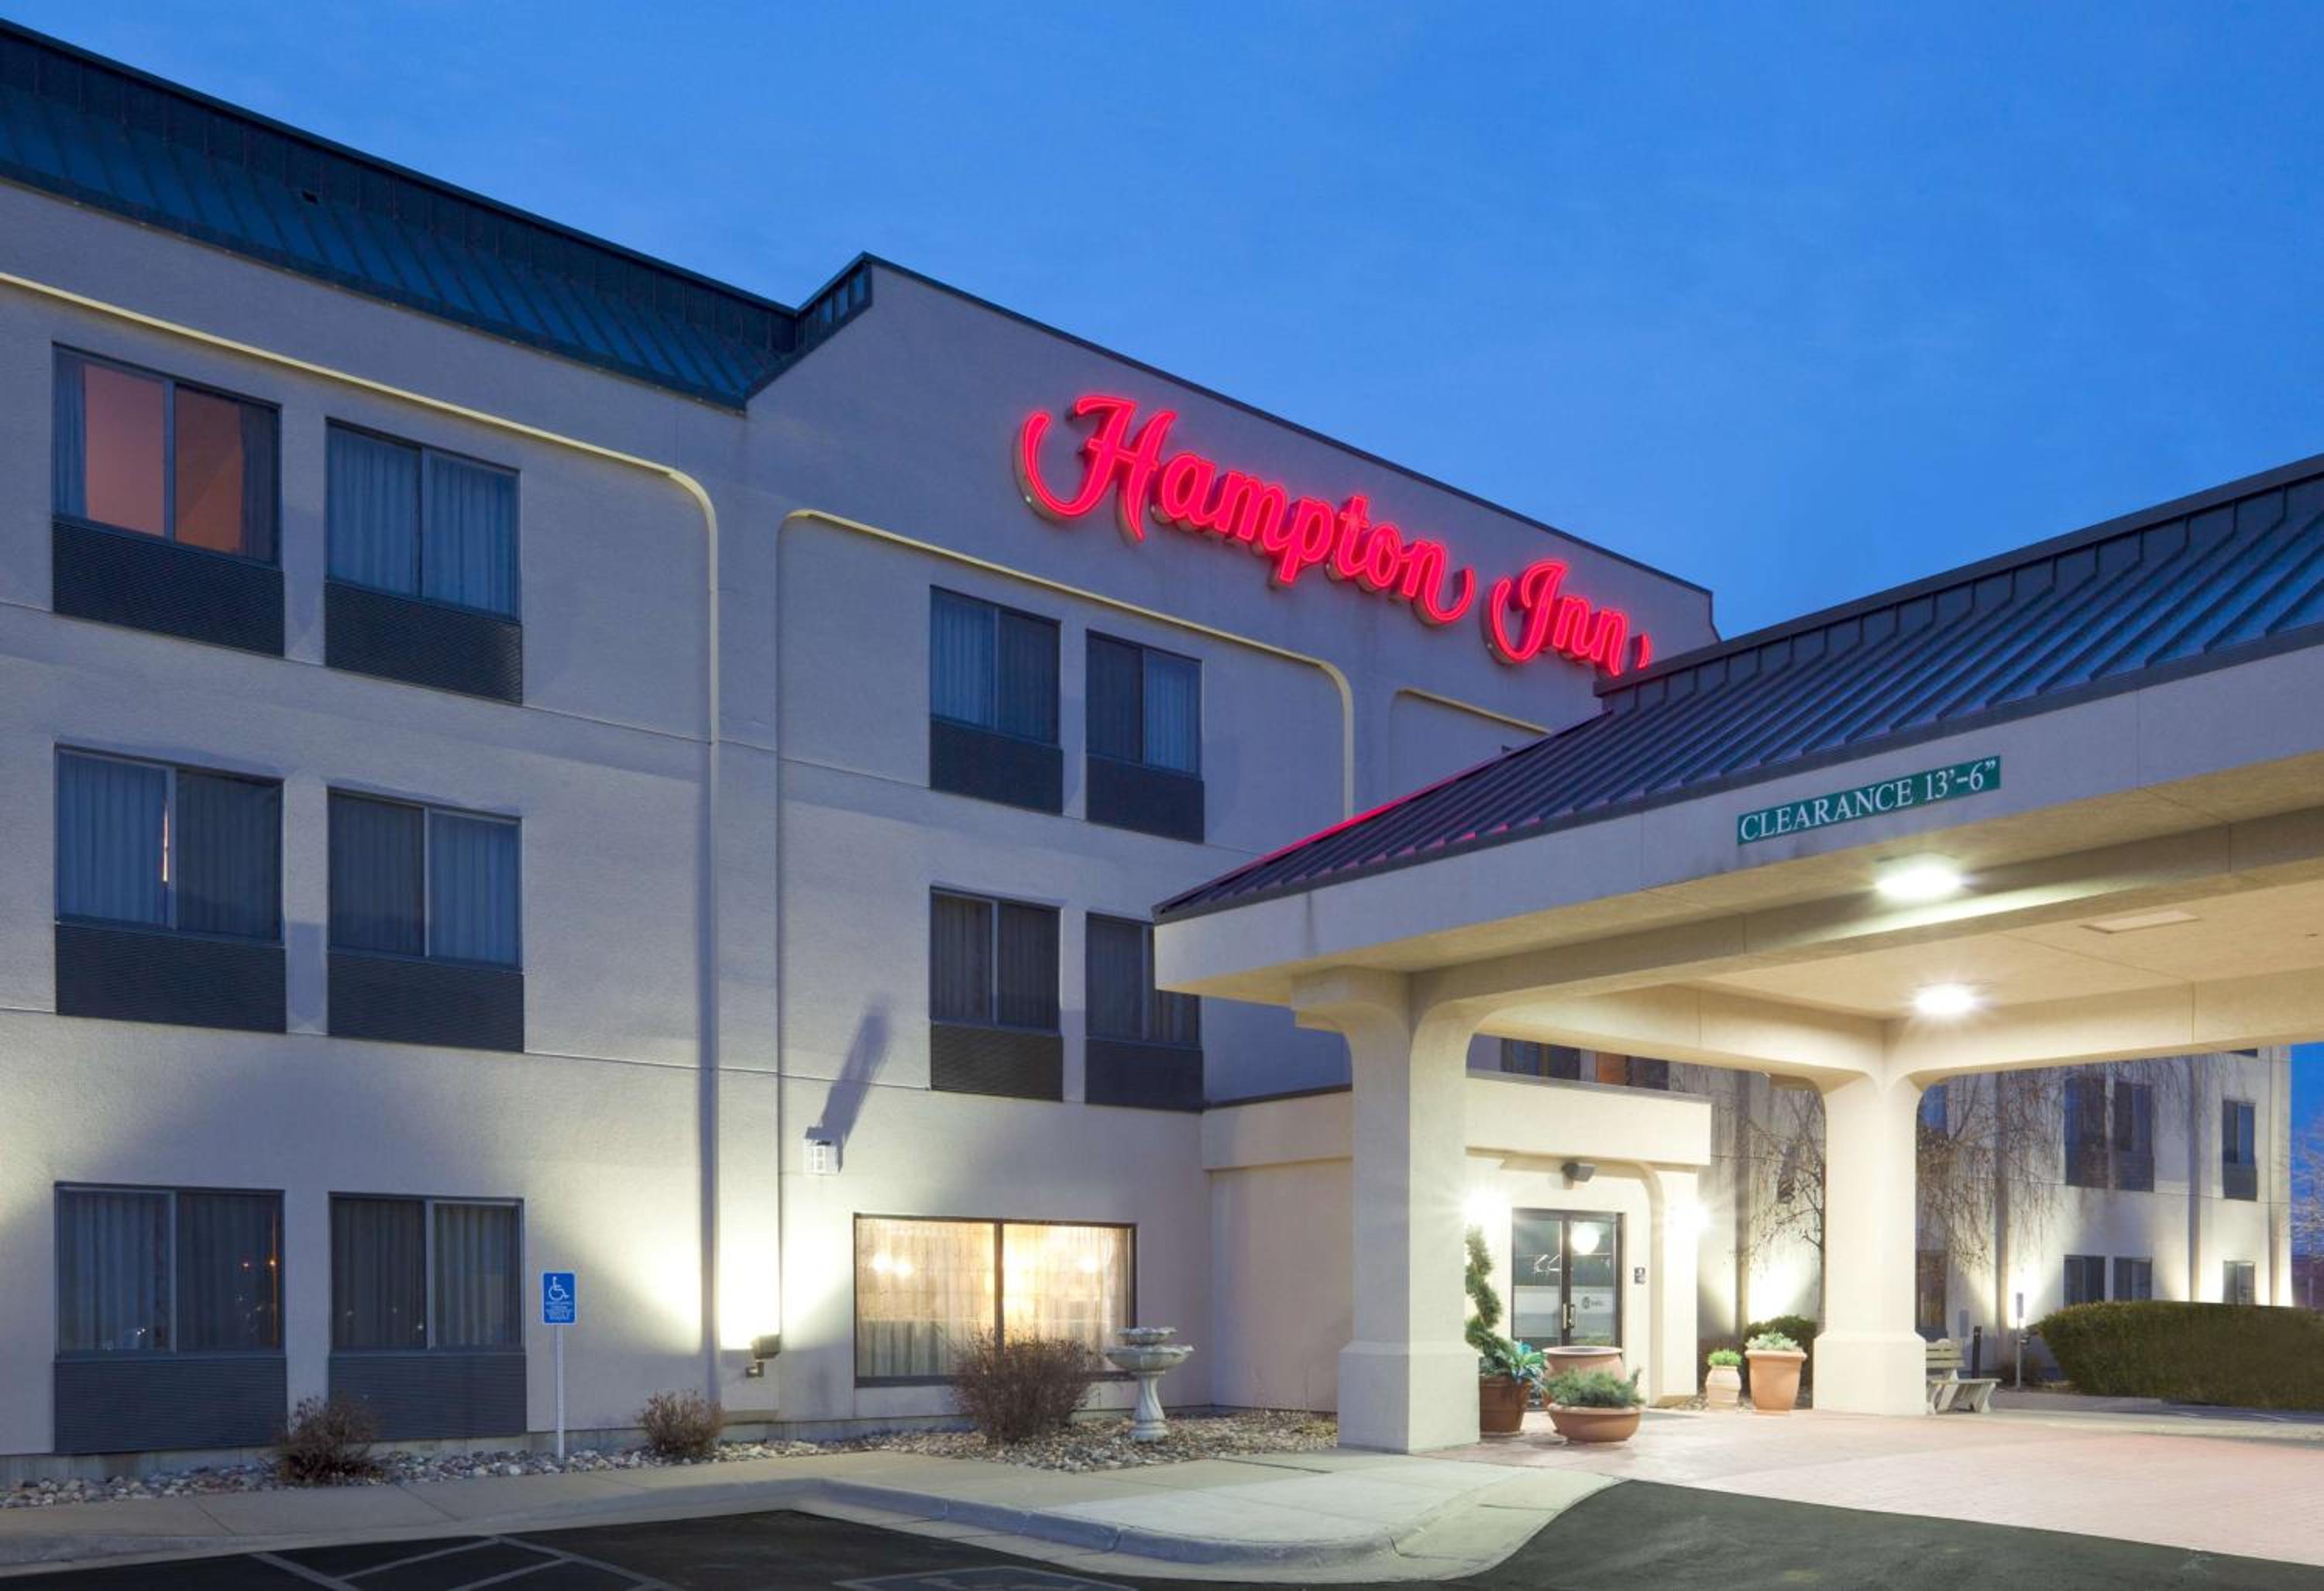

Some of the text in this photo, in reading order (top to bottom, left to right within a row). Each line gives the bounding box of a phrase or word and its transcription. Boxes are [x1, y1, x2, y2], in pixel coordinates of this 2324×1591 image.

[1019, 393, 1652, 677] Hampton Inn
[1740, 778, 1913, 841] CLEARANCE
